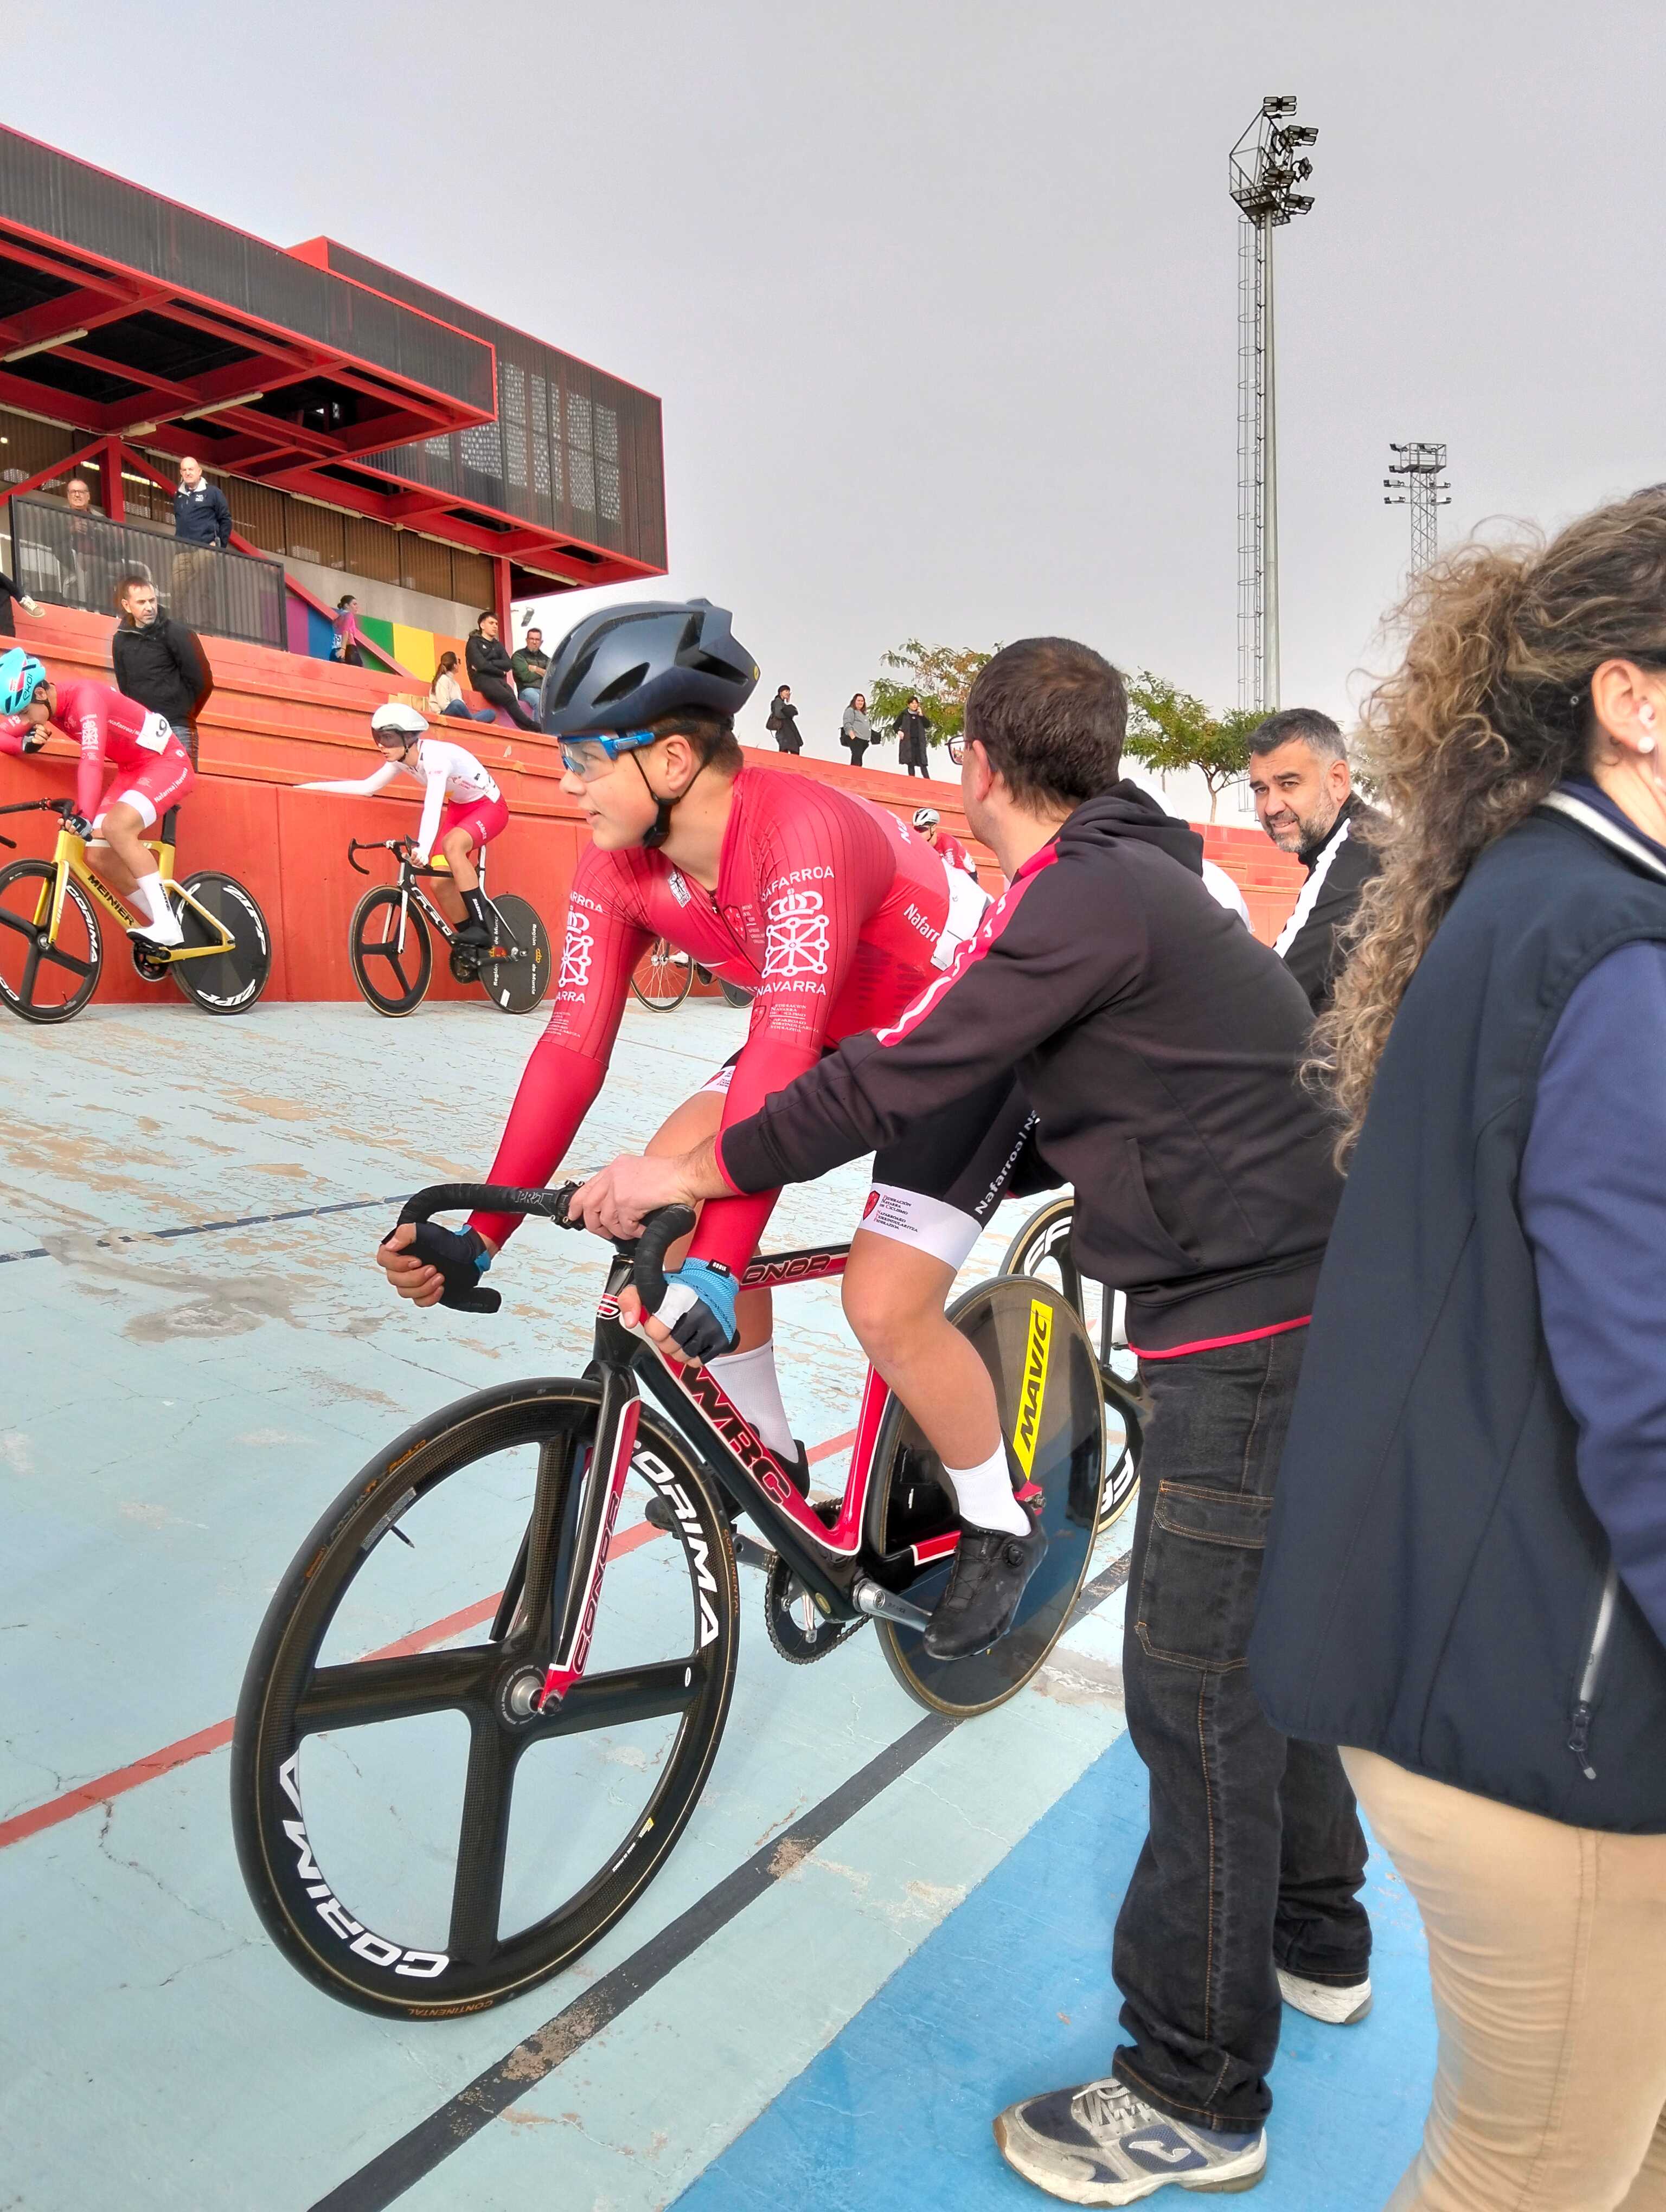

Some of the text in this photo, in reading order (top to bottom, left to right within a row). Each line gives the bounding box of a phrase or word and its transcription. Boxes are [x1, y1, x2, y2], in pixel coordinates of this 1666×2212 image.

[66, 885, 98, 963] CORIMA
[903, 903, 942, 943] Nafarr
[756, 980, 826, 998] NAVARRA
[975, 1141, 1023, 1215] Nafarroa
[741, 1253, 831, 1286] ONOR
[1019, 1309, 1049, 1452] MAVIC
[631, 1439, 719, 1648] ORIMA
[723, 1528, 739, 1617] CONTINENTAL
[279, 1747, 450, 1978] CORIMA
[407, 1999, 494, 2017] CONTINENTAL
